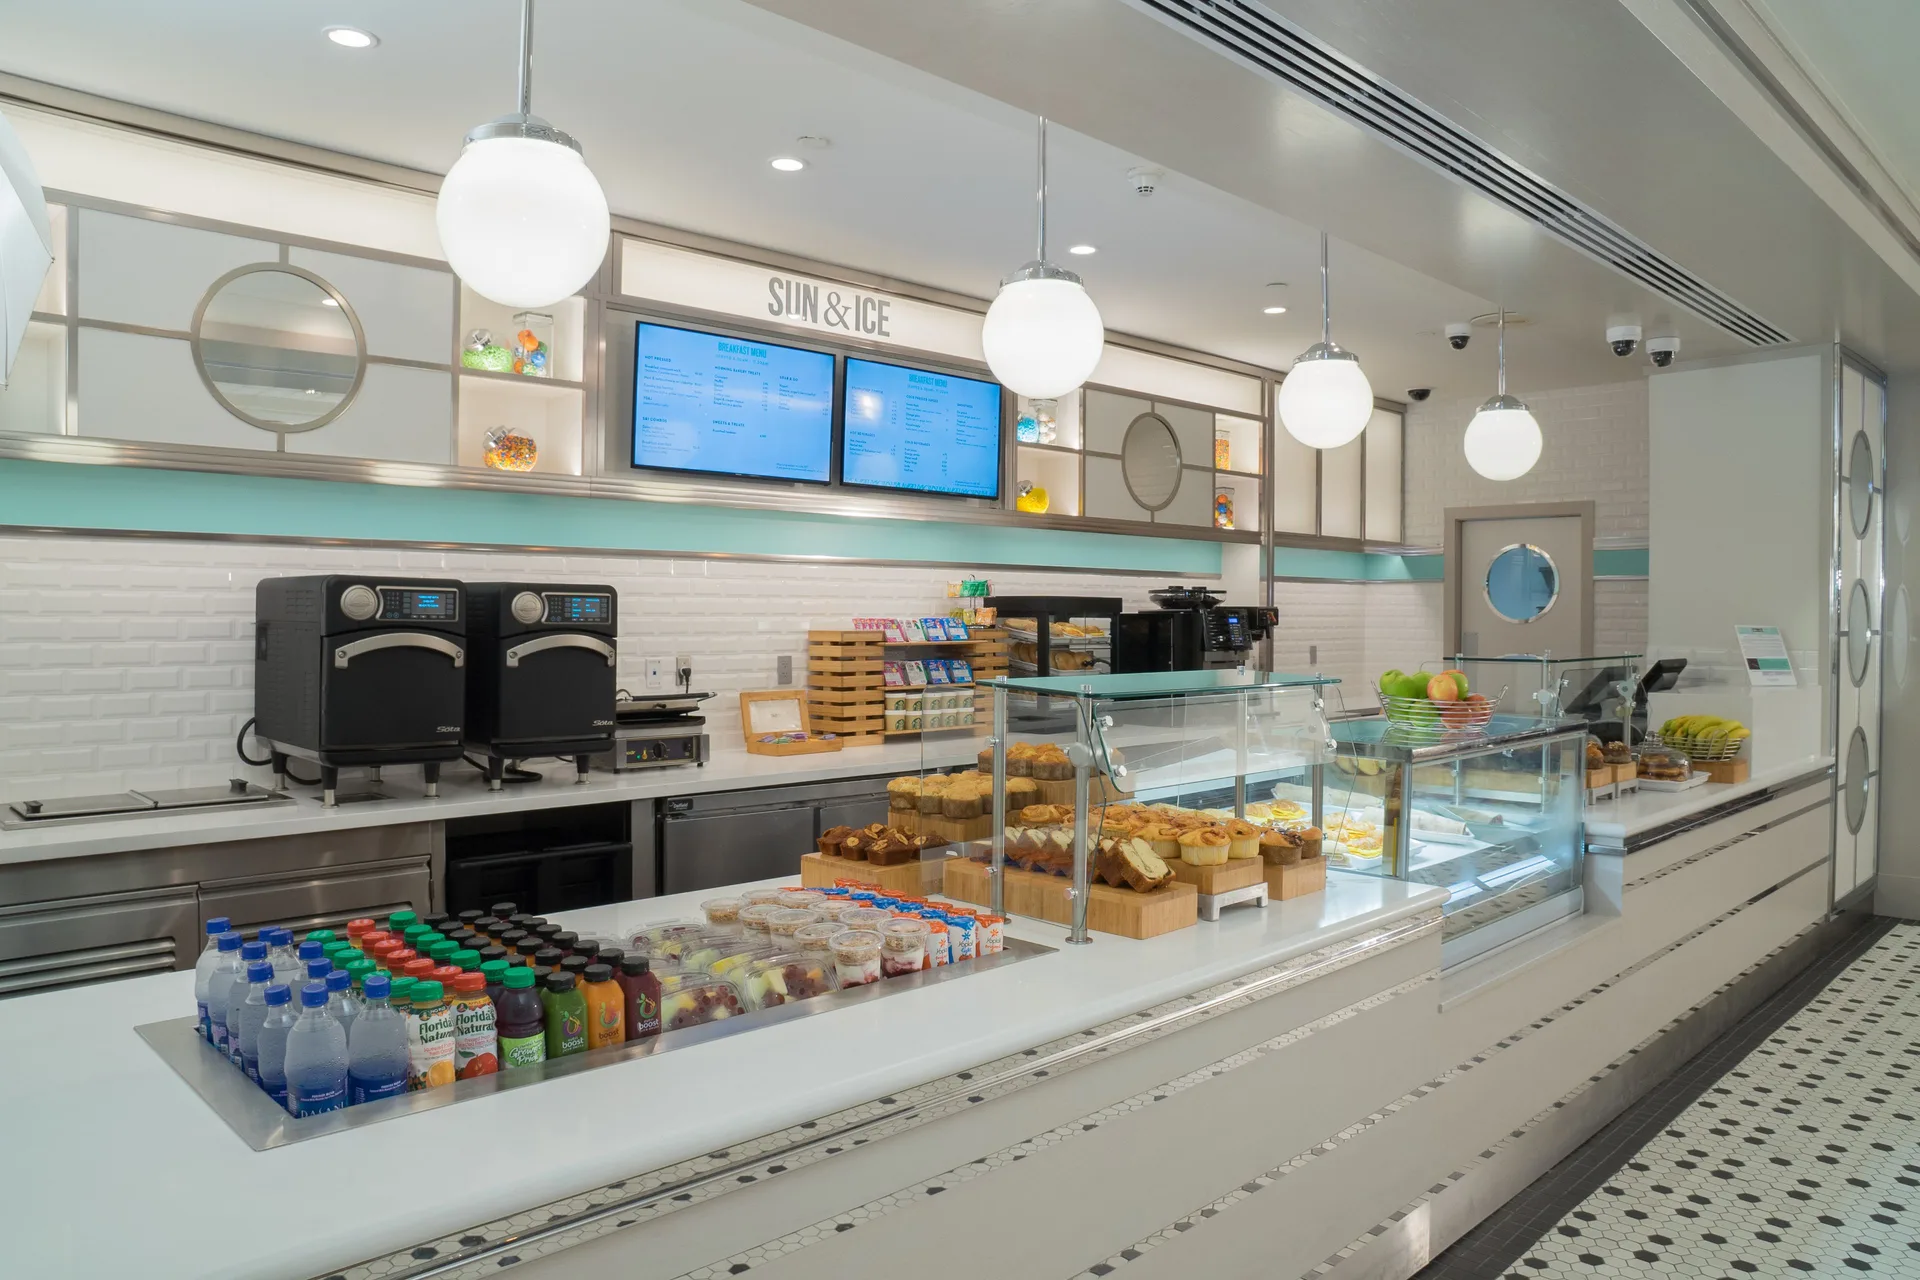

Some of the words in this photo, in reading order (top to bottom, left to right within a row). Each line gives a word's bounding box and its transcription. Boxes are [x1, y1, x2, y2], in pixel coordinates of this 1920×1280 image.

[718, 342, 750, 356] BREAKFAST
[751, 347, 767, 359] MENU
[909, 373, 934, 387] BREAKFAST
[934, 378, 948, 388] MENU
[456, 1021, 494, 1037] Natural
[638, 1018, 659, 1030] boost
[420, 1031, 452, 1045] Natur
[599, 1028, 619, 1040] boost
[562, 1036, 584, 1049] boost
